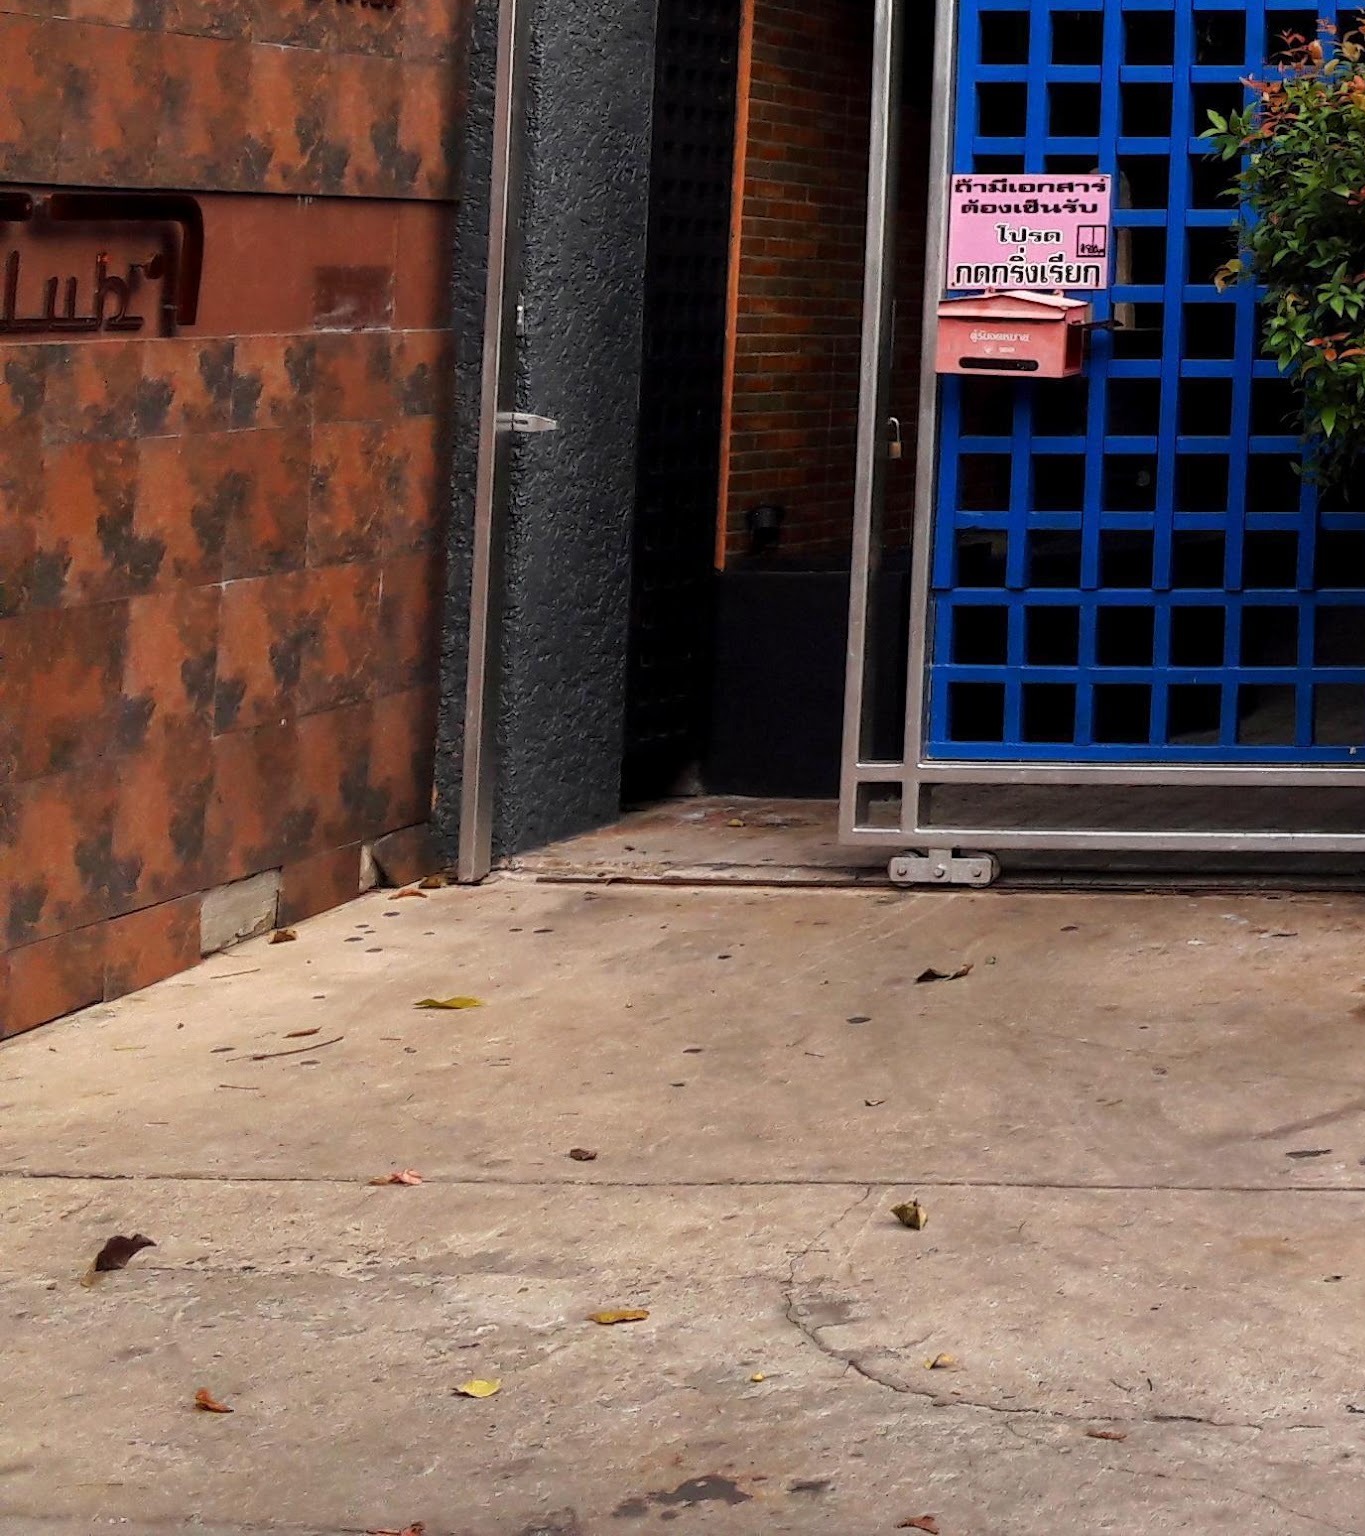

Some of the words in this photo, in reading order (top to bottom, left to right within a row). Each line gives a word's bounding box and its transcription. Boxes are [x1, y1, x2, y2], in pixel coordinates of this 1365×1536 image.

[996, 224, 1062, 243] โปรด
[955, 245, 1101, 285] กดกริ่งเรียก
